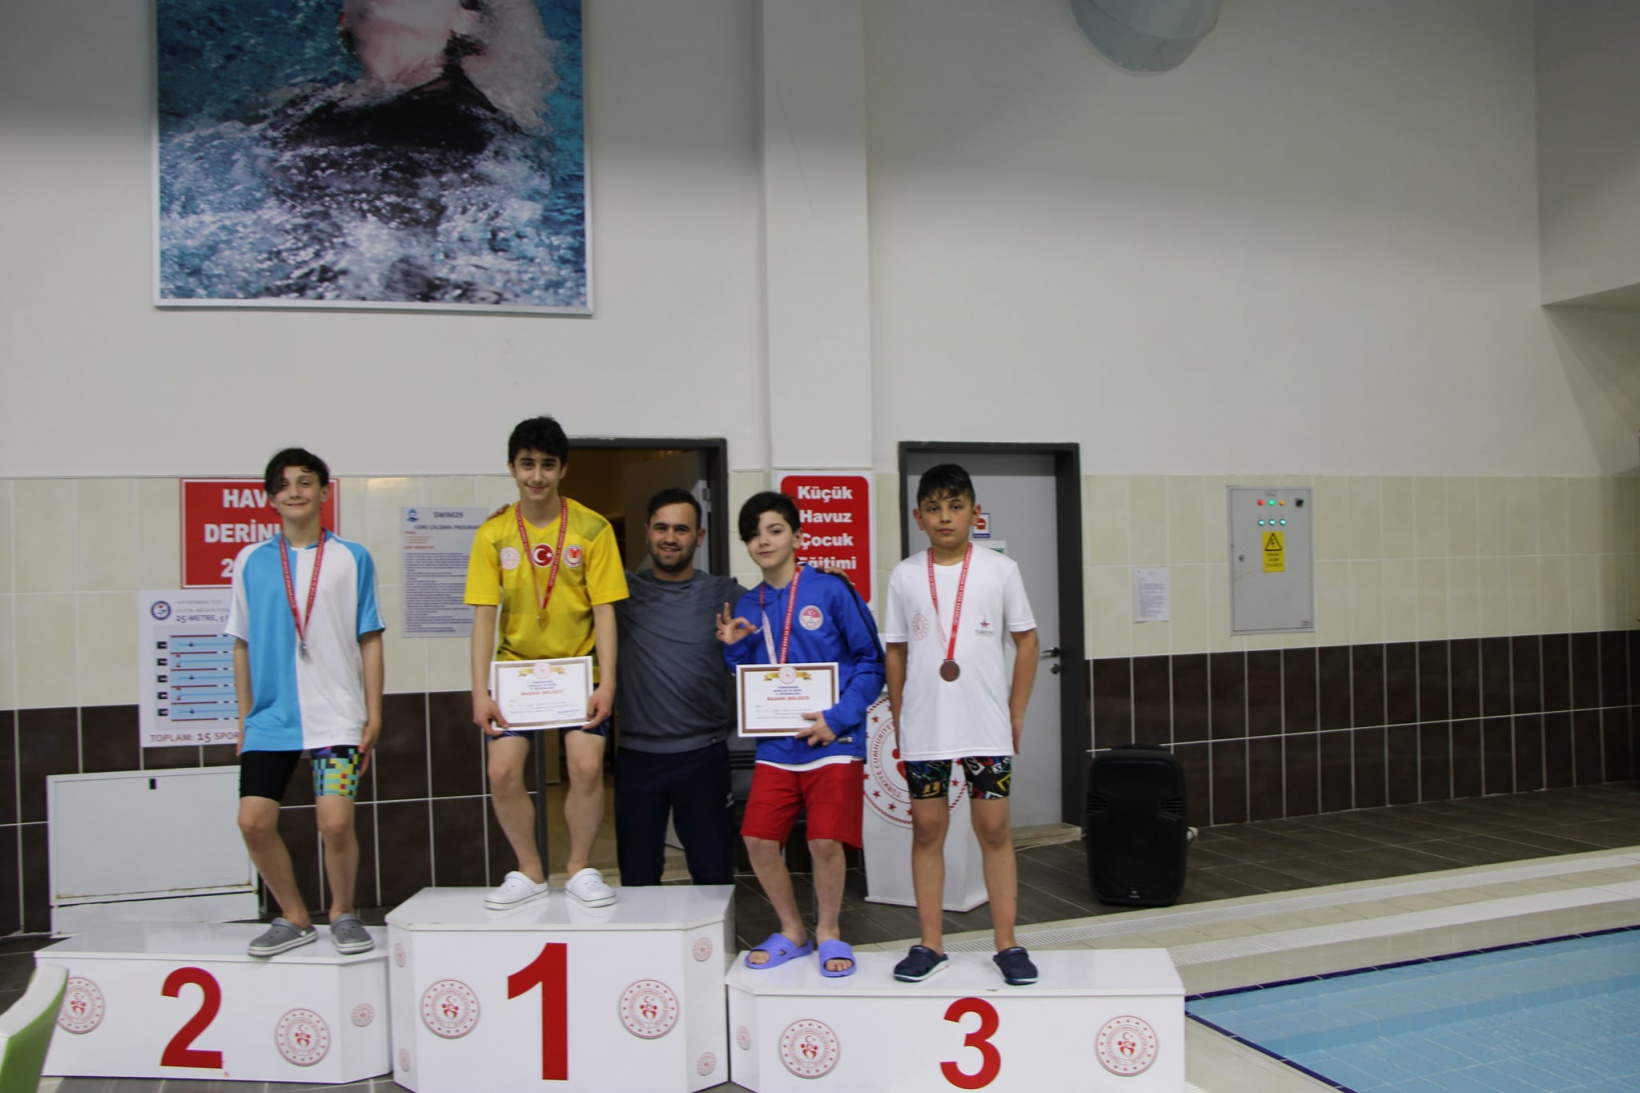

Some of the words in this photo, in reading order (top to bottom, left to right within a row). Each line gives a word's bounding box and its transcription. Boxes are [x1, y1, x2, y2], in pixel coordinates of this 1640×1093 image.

[223, 488, 268, 508] HAV
[797, 486, 853, 502] Küçük
[800, 510, 852, 523] Havuz
[800, 533, 853, 550] Çocuk
[150, 733, 194, 743] TOPLAM:
[197, 732, 211, 743] 15
[214, 731, 240, 741] SPOR
[160, 966, 223, 1069] 2
[507, 942, 568, 1080] 1
[939, 996, 1001, 1090] 3
